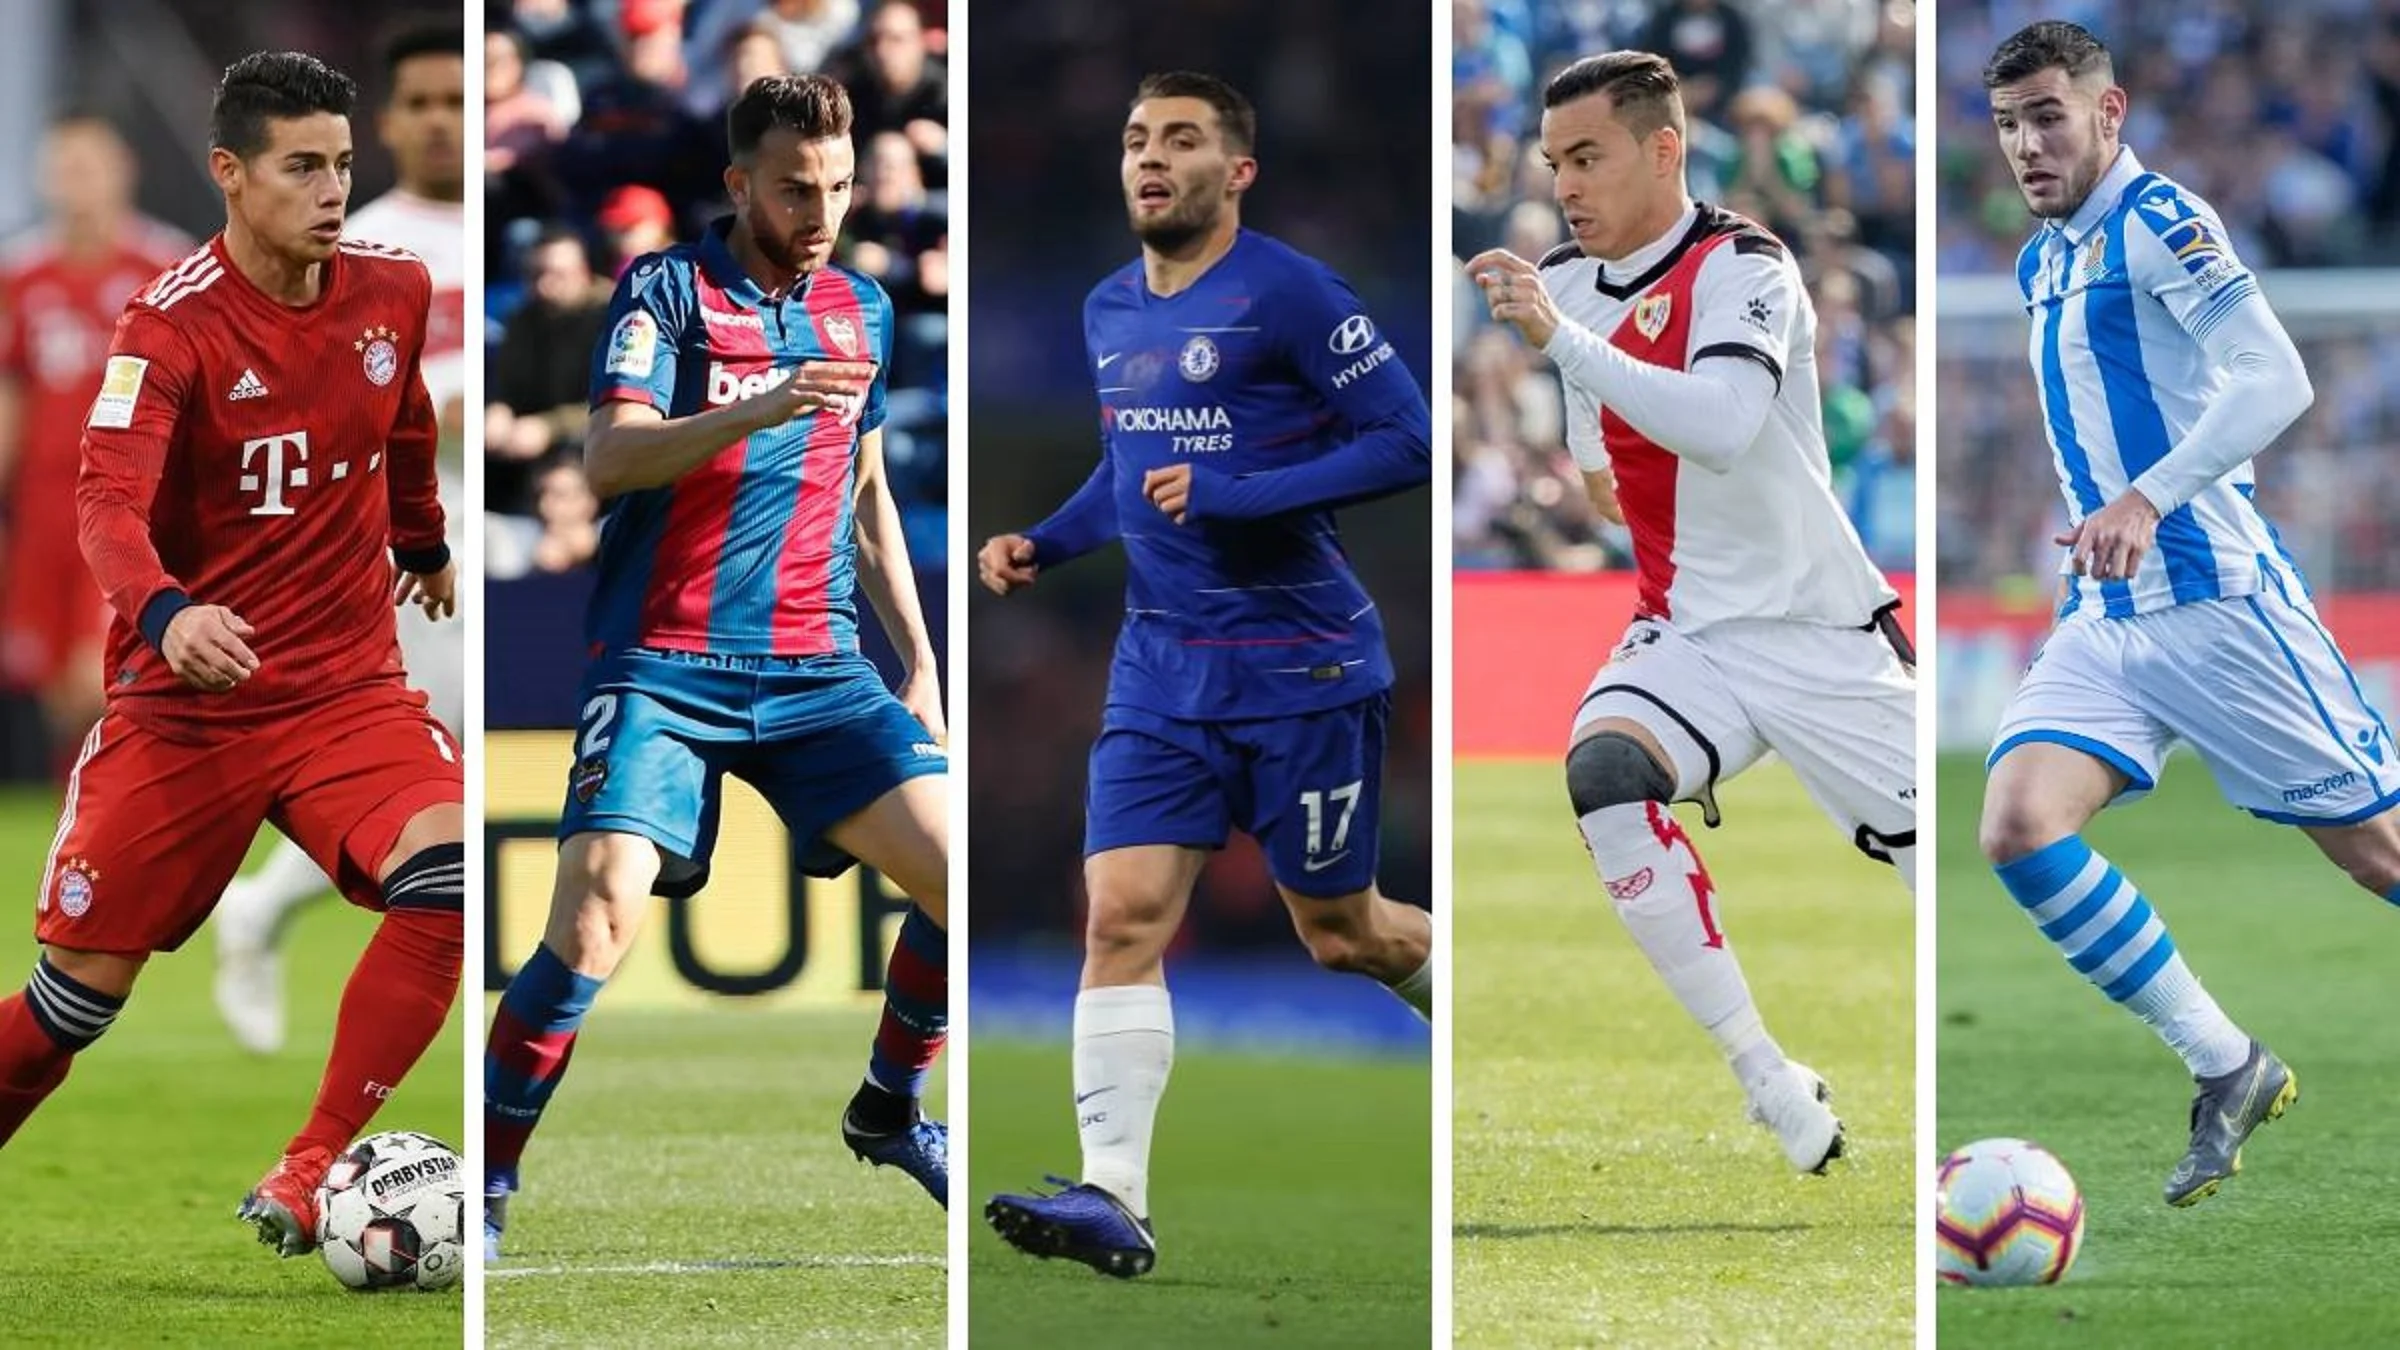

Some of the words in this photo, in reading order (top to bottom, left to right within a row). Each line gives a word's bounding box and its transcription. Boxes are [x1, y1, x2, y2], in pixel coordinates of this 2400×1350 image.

[708, 361, 868, 427] bety
[1113, 406, 1232, 432] YOKOHAMA
[1172, 433, 1233, 454] TYRES
[2283, 771, 2355, 803] macron
[1299, 779, 1363, 854] 17
[371, 1156, 456, 1197] DERBYSTAR
